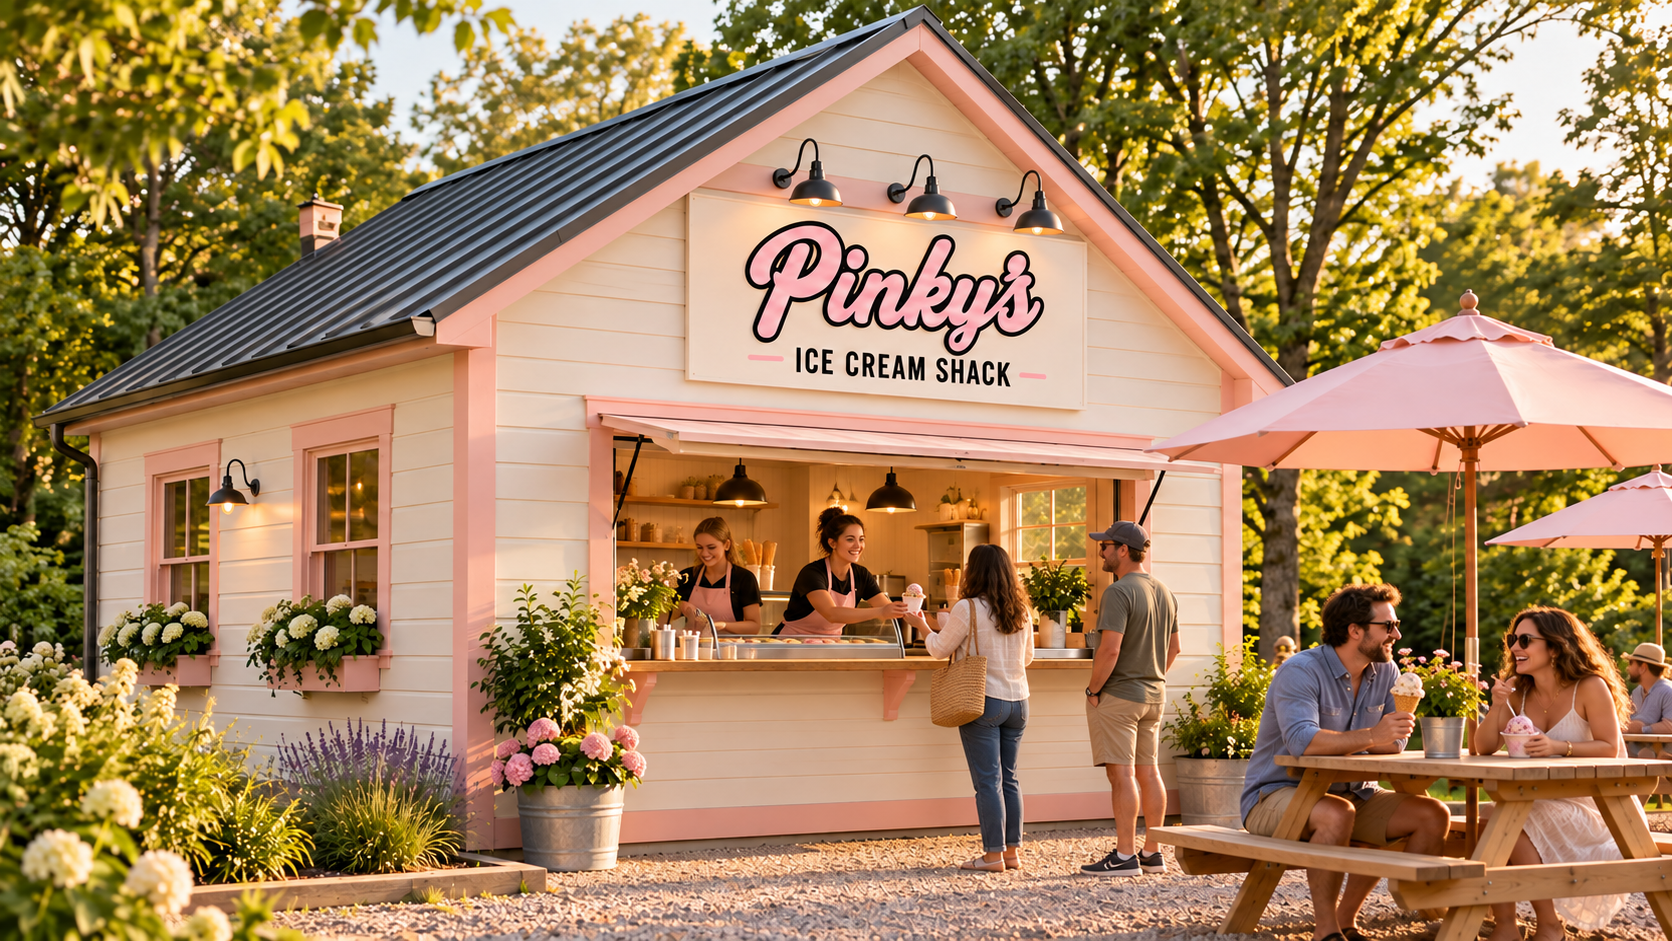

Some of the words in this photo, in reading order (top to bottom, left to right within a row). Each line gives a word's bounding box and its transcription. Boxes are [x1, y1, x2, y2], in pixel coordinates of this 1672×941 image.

[745, 221, 1044, 356] Pinky's
[796, 347, 834, 375] ICE
[845, 351, 926, 381] CREAM
[936, 357, 1011, 387] SHACK
